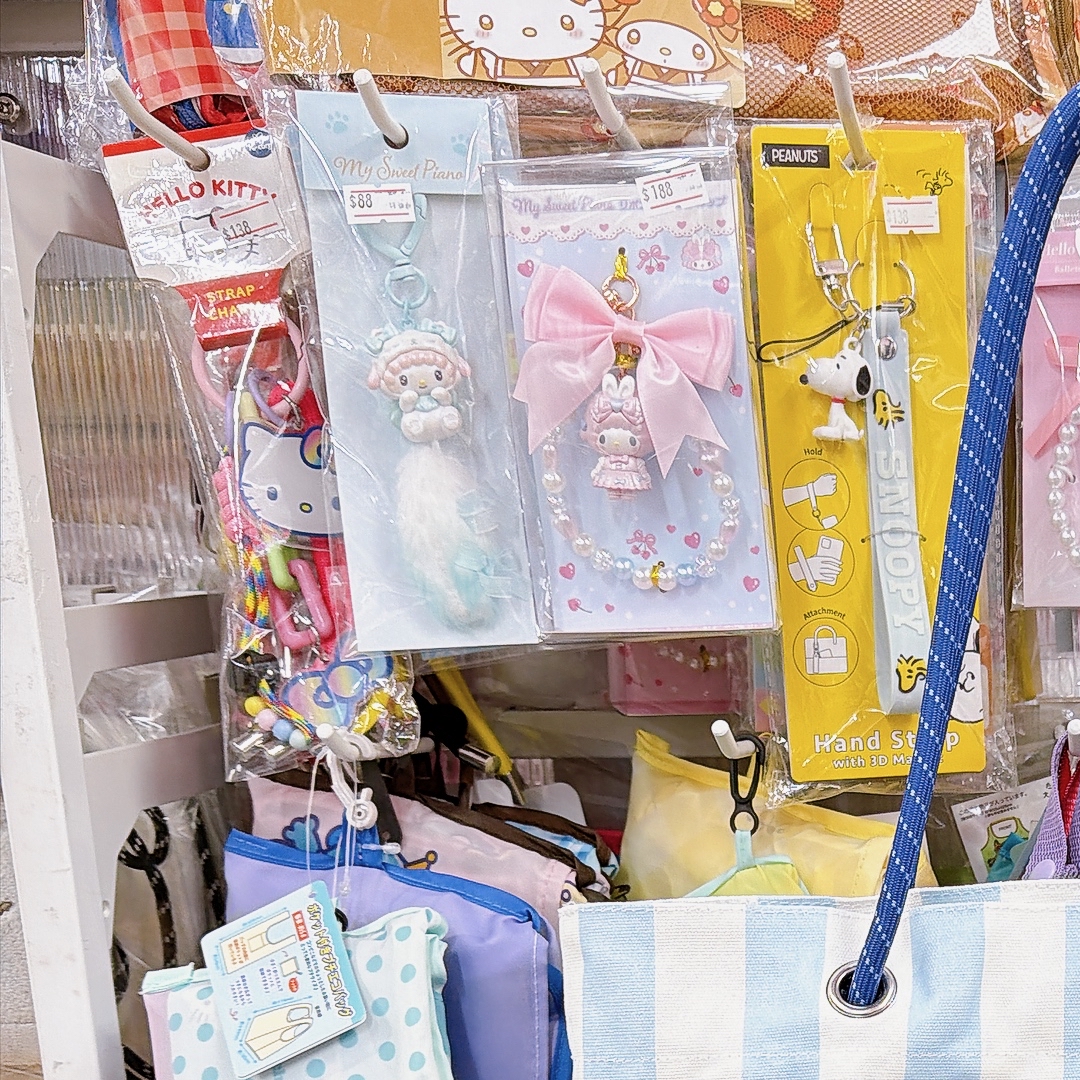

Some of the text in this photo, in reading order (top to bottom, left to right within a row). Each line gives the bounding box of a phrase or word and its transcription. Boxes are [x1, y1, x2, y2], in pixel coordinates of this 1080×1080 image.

[771, 148, 819, 163] PEANUTS
[333, 155, 464, 183] My Sweet Piano
[642, 181, 674, 202] $188
[349, 193, 373, 209] $88
[222, 220, 252, 241] $138
[206, 284, 256, 302] STRAP
[803, 448, 823, 456] Hold
[875, 450, 927, 636] SNOOPY
[803, 606, 847, 621] Attachment
[814, 730, 960, 753] Hand Stp
[833, 755, 866, 769] with
[870, 755, 888, 767] 3D
